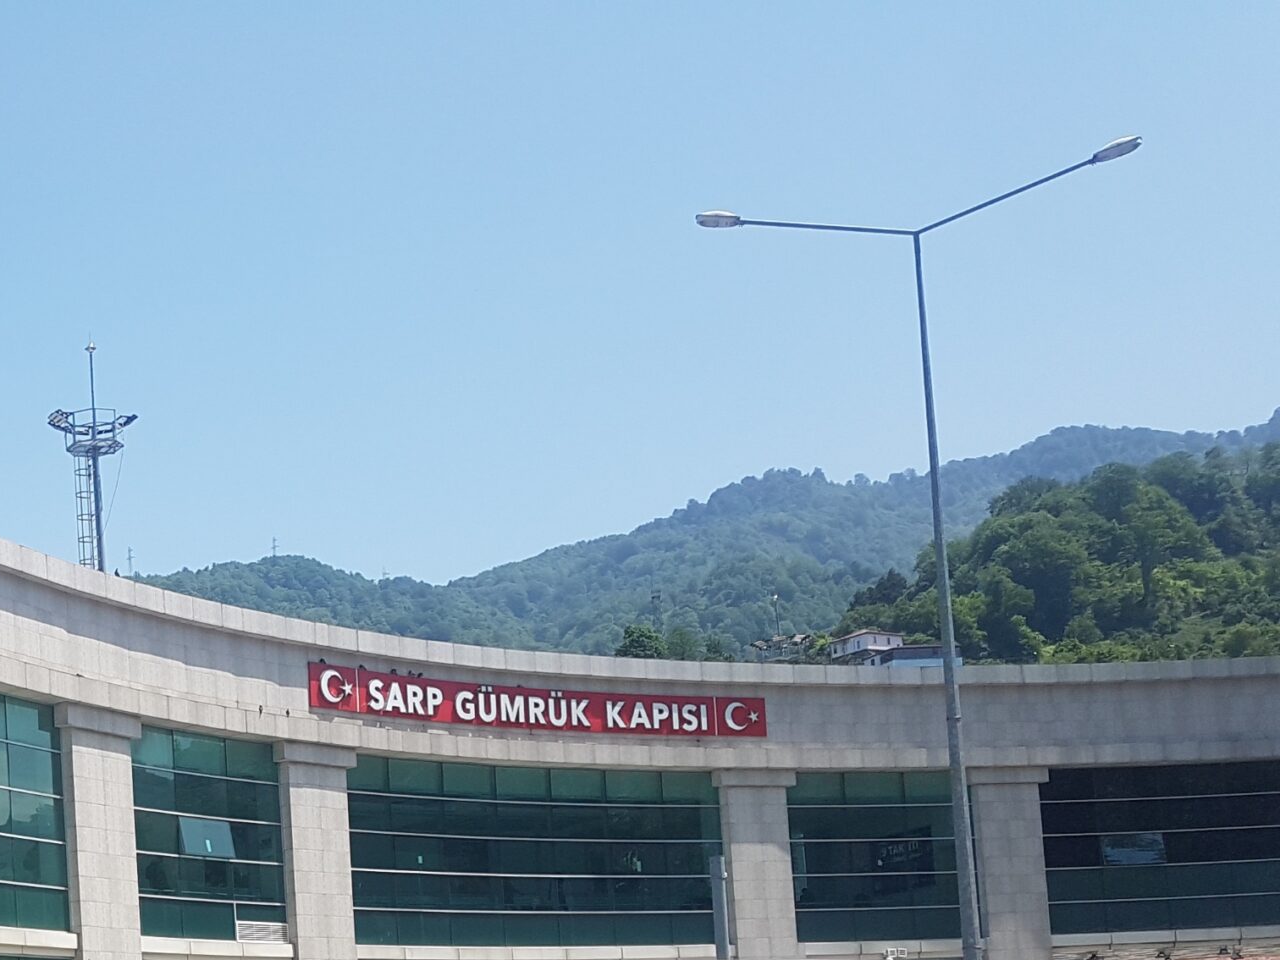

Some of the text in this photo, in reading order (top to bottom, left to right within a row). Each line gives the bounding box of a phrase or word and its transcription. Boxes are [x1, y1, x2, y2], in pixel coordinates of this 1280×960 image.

[368, 679, 708, 731] SARP GÜMRÜK KAPISI
